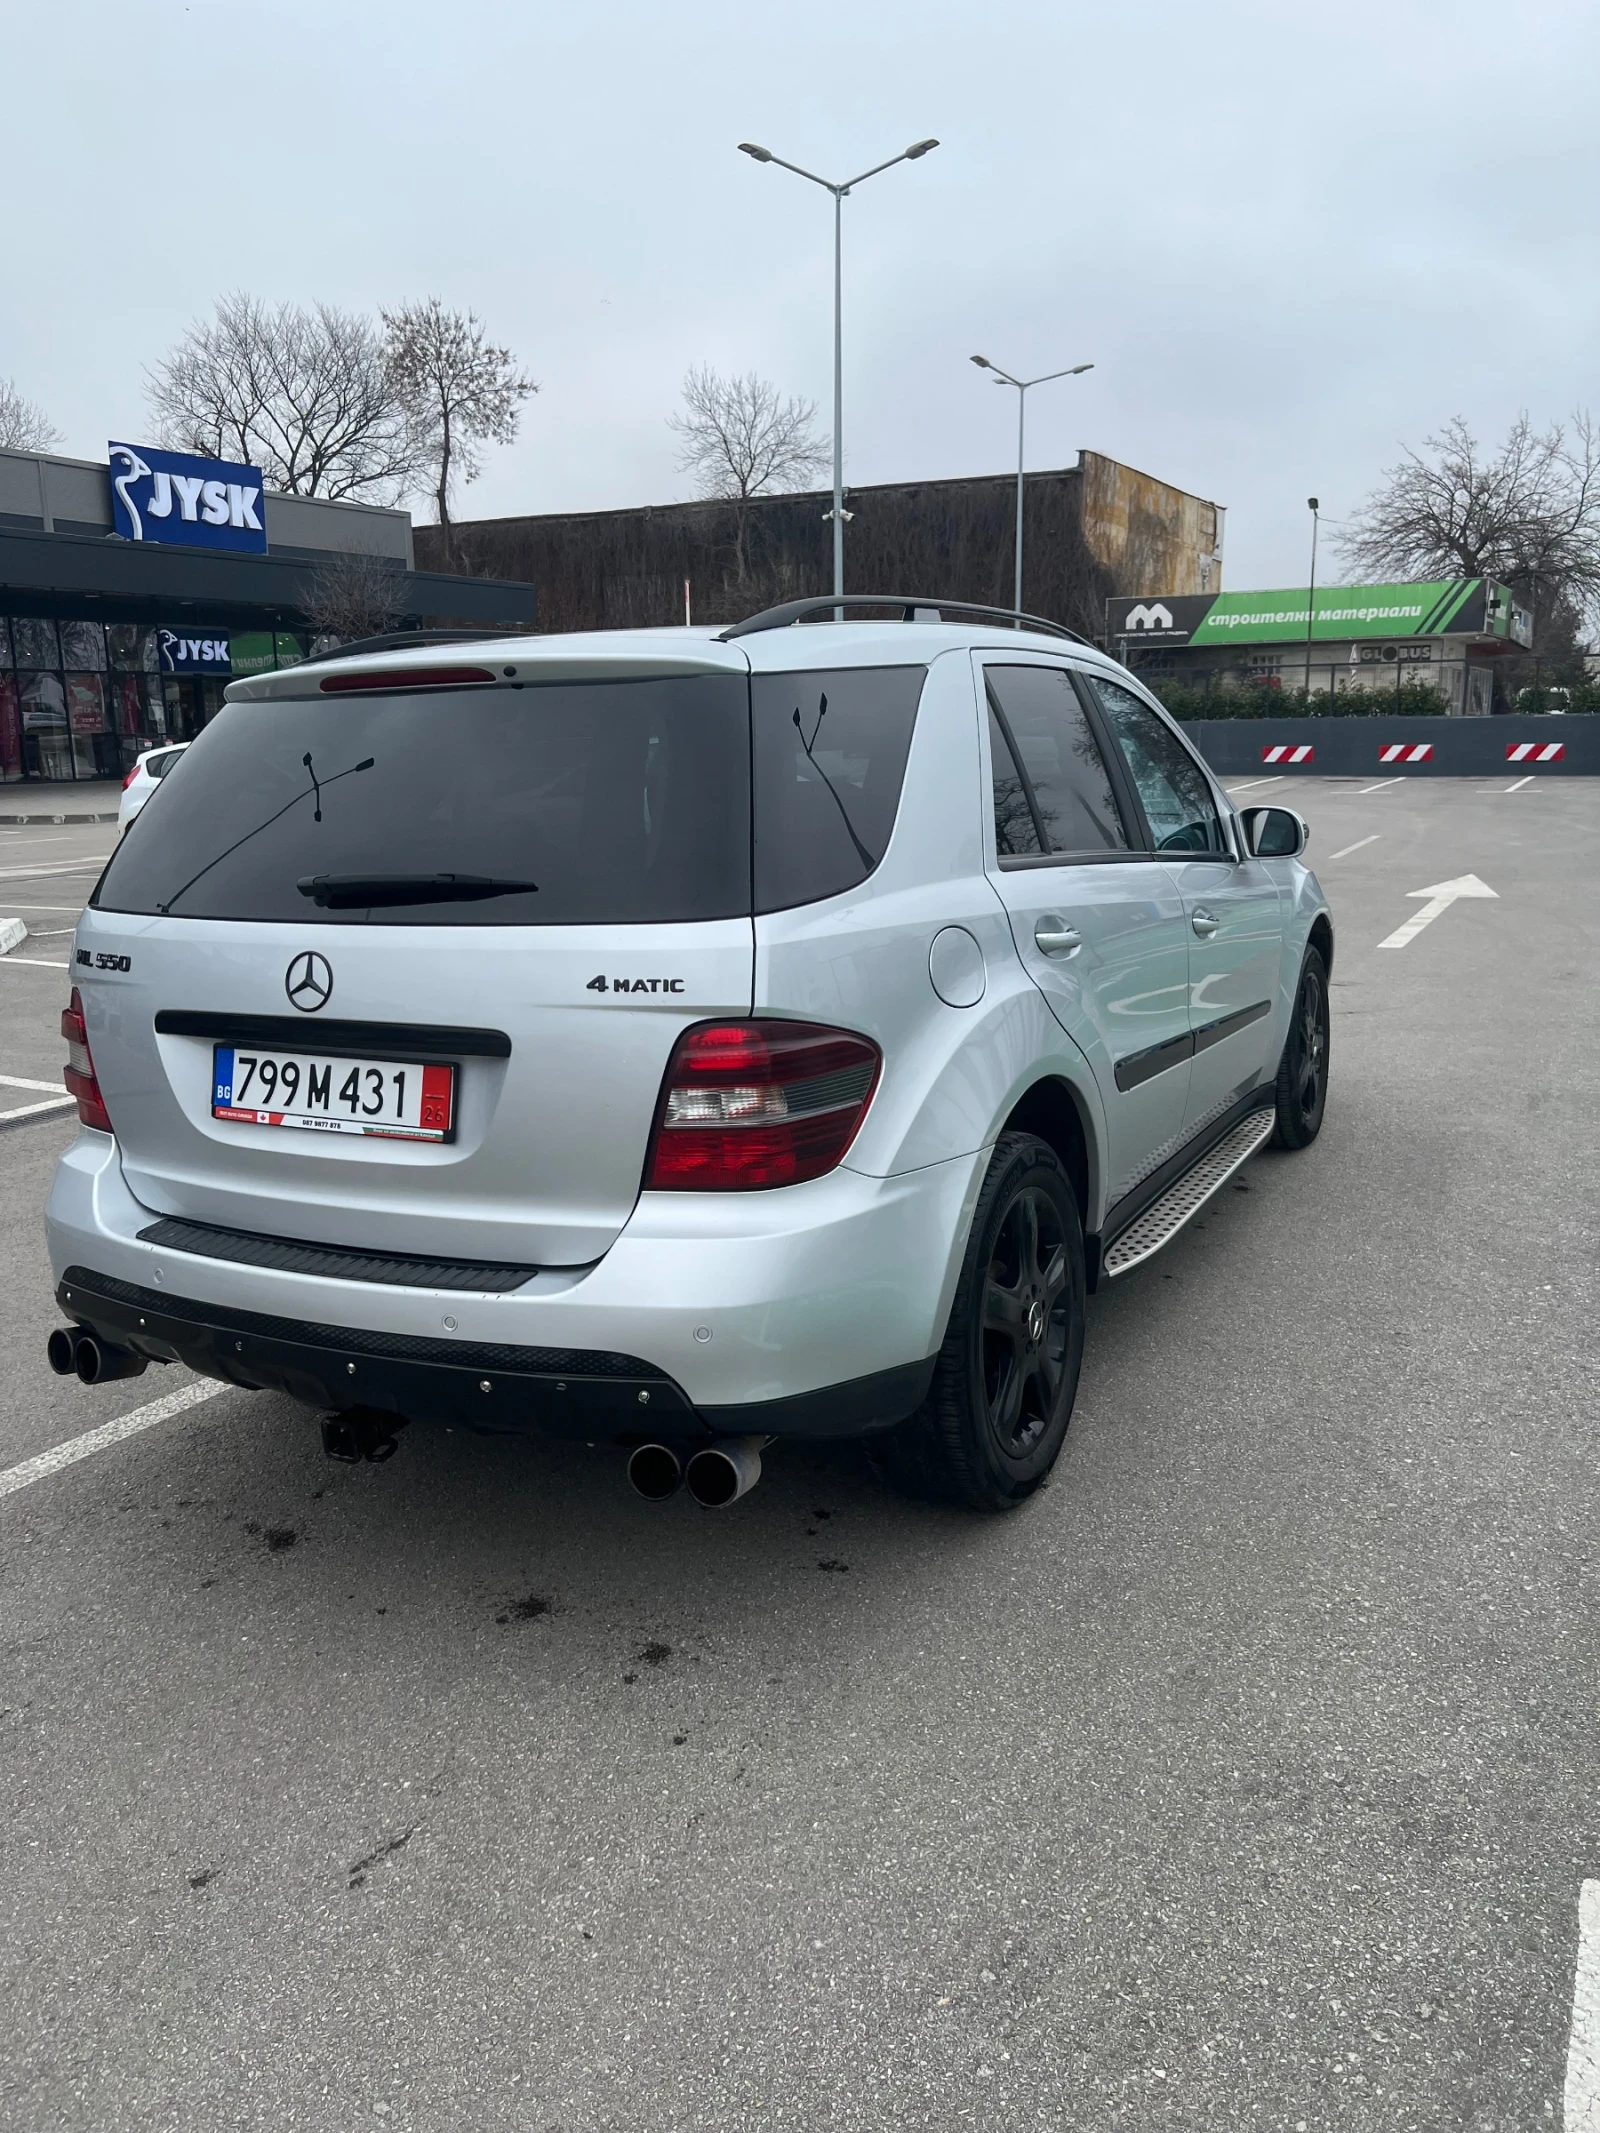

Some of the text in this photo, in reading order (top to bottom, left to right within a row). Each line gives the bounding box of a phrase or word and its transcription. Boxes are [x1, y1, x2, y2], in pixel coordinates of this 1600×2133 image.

[147, 472, 263, 530] JYSK
[1207, 605, 1422, 628] строителни материали
[177, 639, 231, 661] JYSK
[95, 953, 131, 972] 550
[217, 1085, 231, 1099] BG
[425, 1105, 443, 1121] 26
